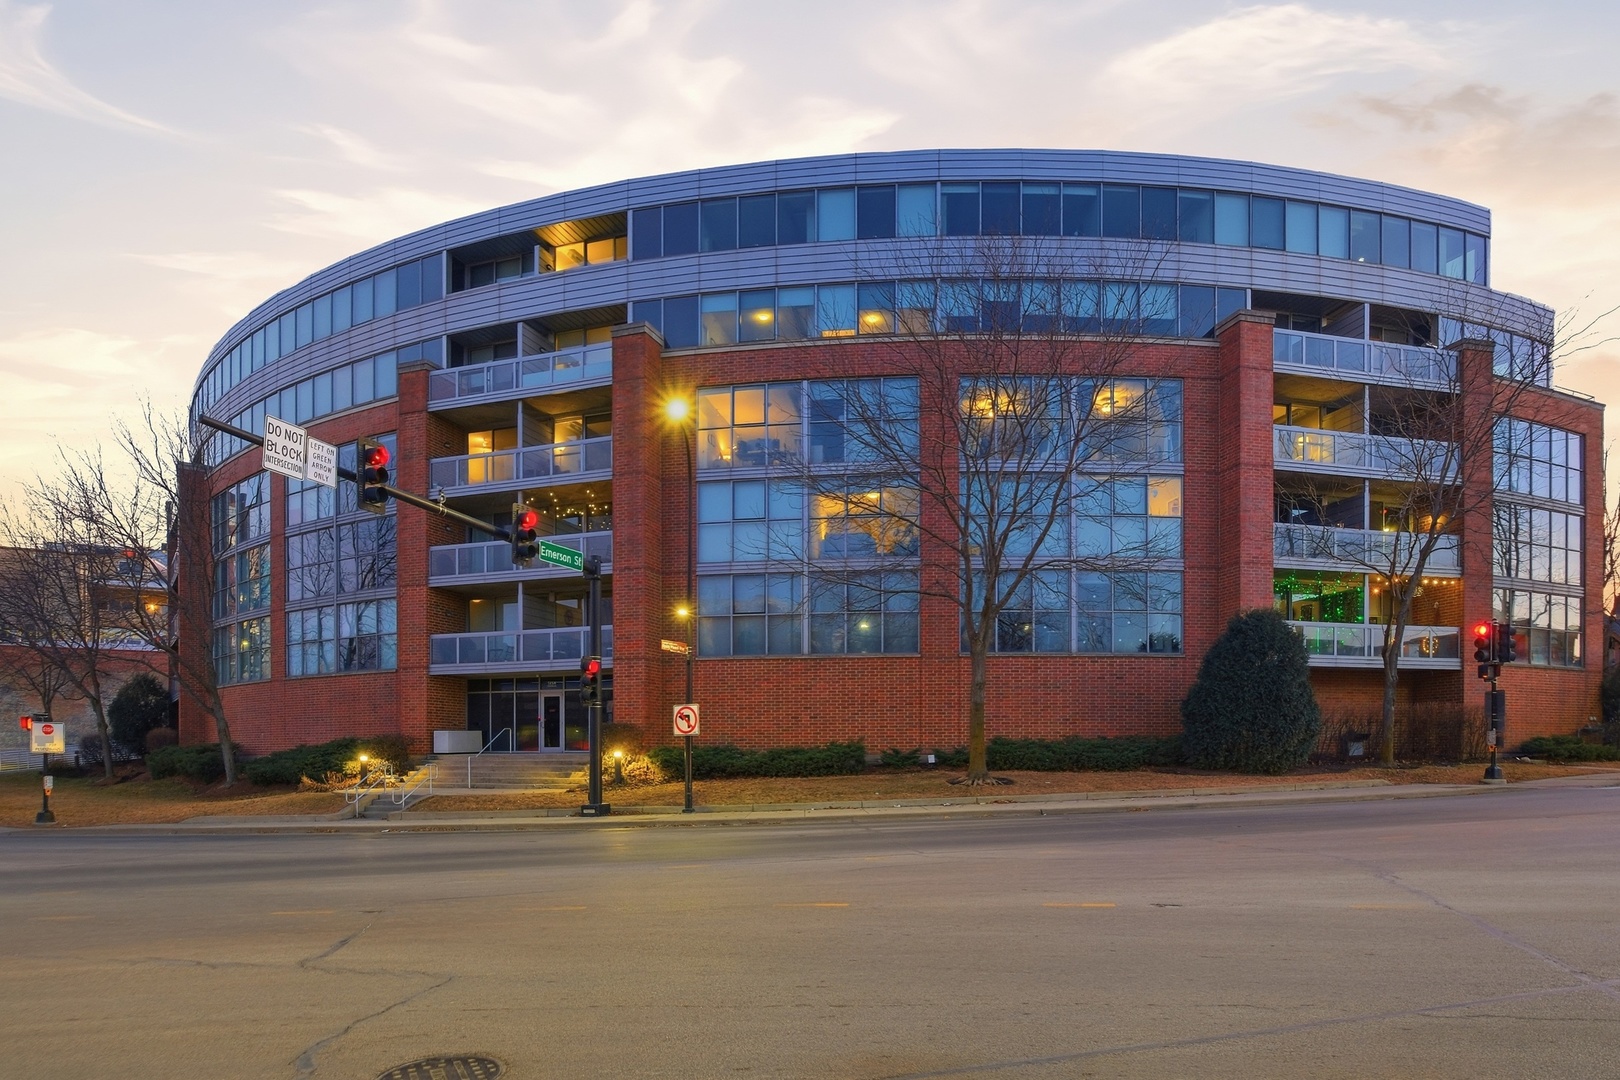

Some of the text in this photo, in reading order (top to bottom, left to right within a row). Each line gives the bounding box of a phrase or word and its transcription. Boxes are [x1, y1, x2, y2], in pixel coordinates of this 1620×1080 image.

[268, 422, 303, 445] DO NOT
[267, 439, 302, 462] BLOCK
[311, 442, 335, 456] LEFT ON
[265, 454, 302, 473] INTERSECTION
[313, 452, 332, 464] GREEN
[312, 462, 332, 474] ARROW
[314, 472, 329, 482] ONLY
[541, 546, 582, 566] Emerson St
